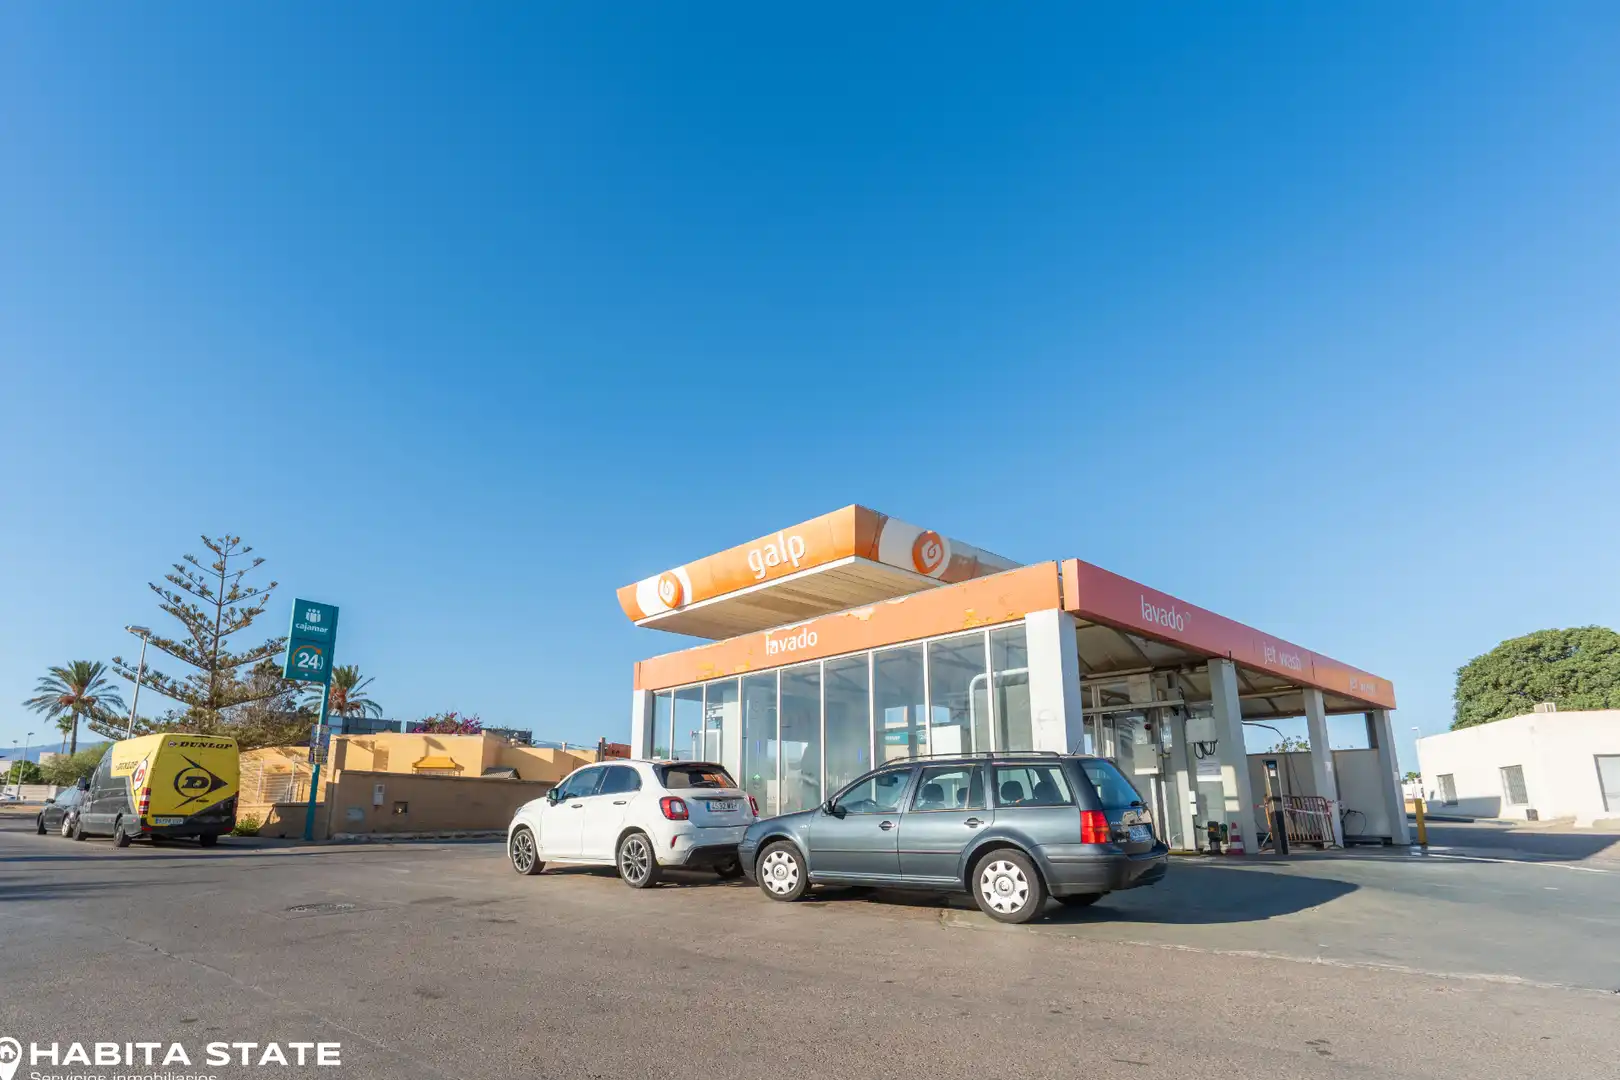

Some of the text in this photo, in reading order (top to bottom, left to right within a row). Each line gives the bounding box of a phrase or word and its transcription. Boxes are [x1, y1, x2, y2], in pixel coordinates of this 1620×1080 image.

[748, 530, 805, 580] galp
[1140, 594, 1184, 632] lavado
[295, 622, 328, 633] cajamar
[764, 627, 818, 656] lavado
[298, 652, 319, 669] 24
[180, 741, 233, 750] DUNLOP
